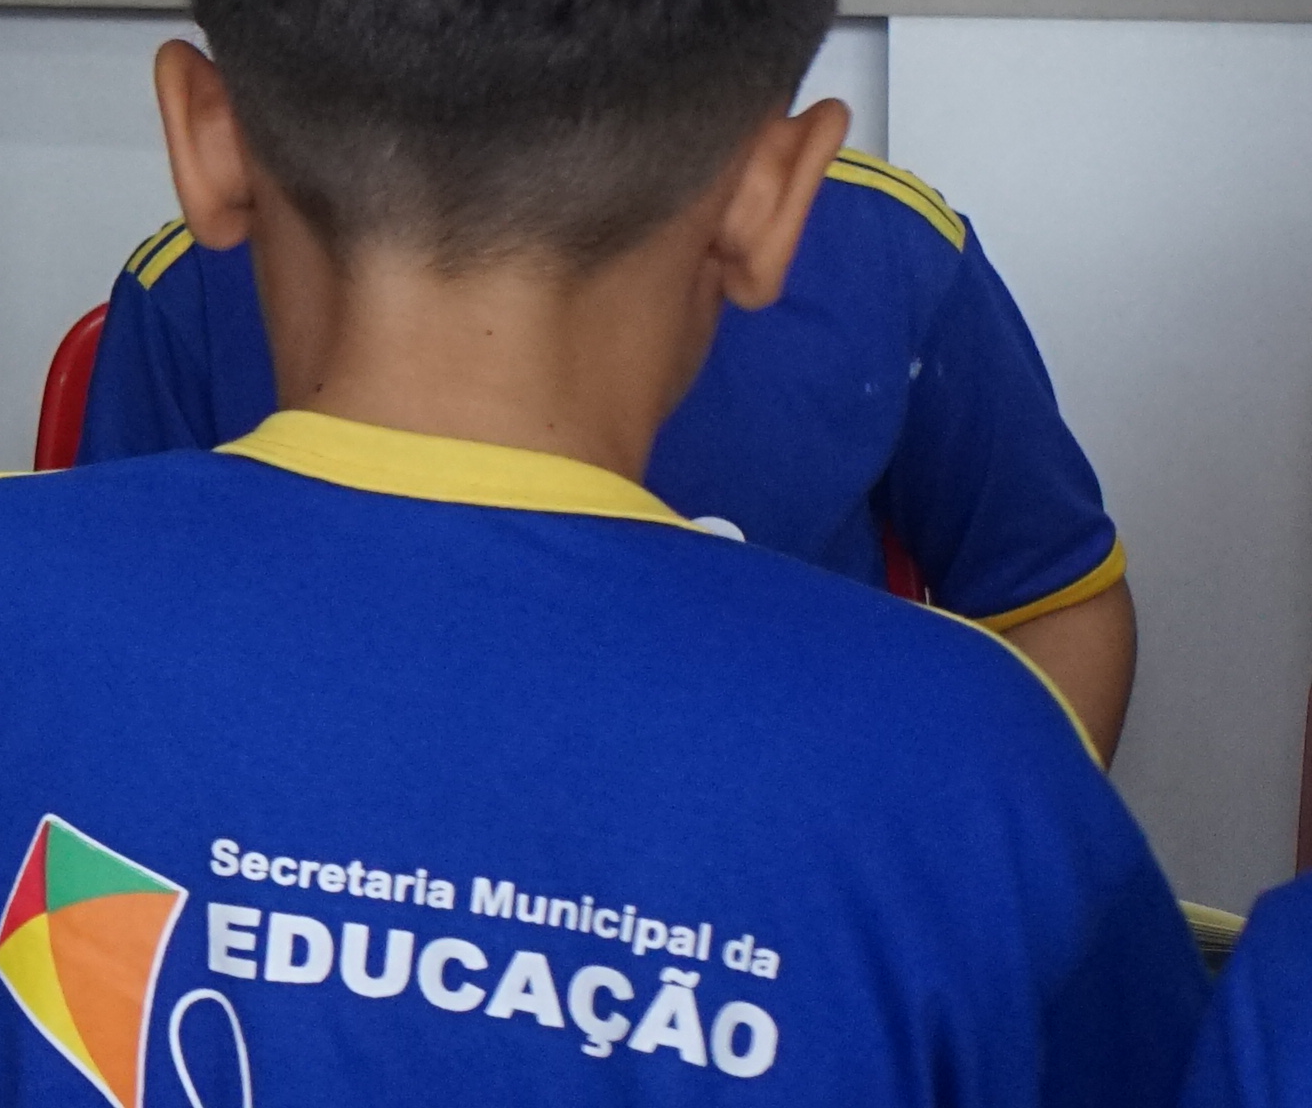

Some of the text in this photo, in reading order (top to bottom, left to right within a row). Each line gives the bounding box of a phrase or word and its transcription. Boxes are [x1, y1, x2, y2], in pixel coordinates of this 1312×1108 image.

[210, 837, 781, 981] Secretaria Municipal da
[206, 902, 780, 1079] EDUCAÇÃO
